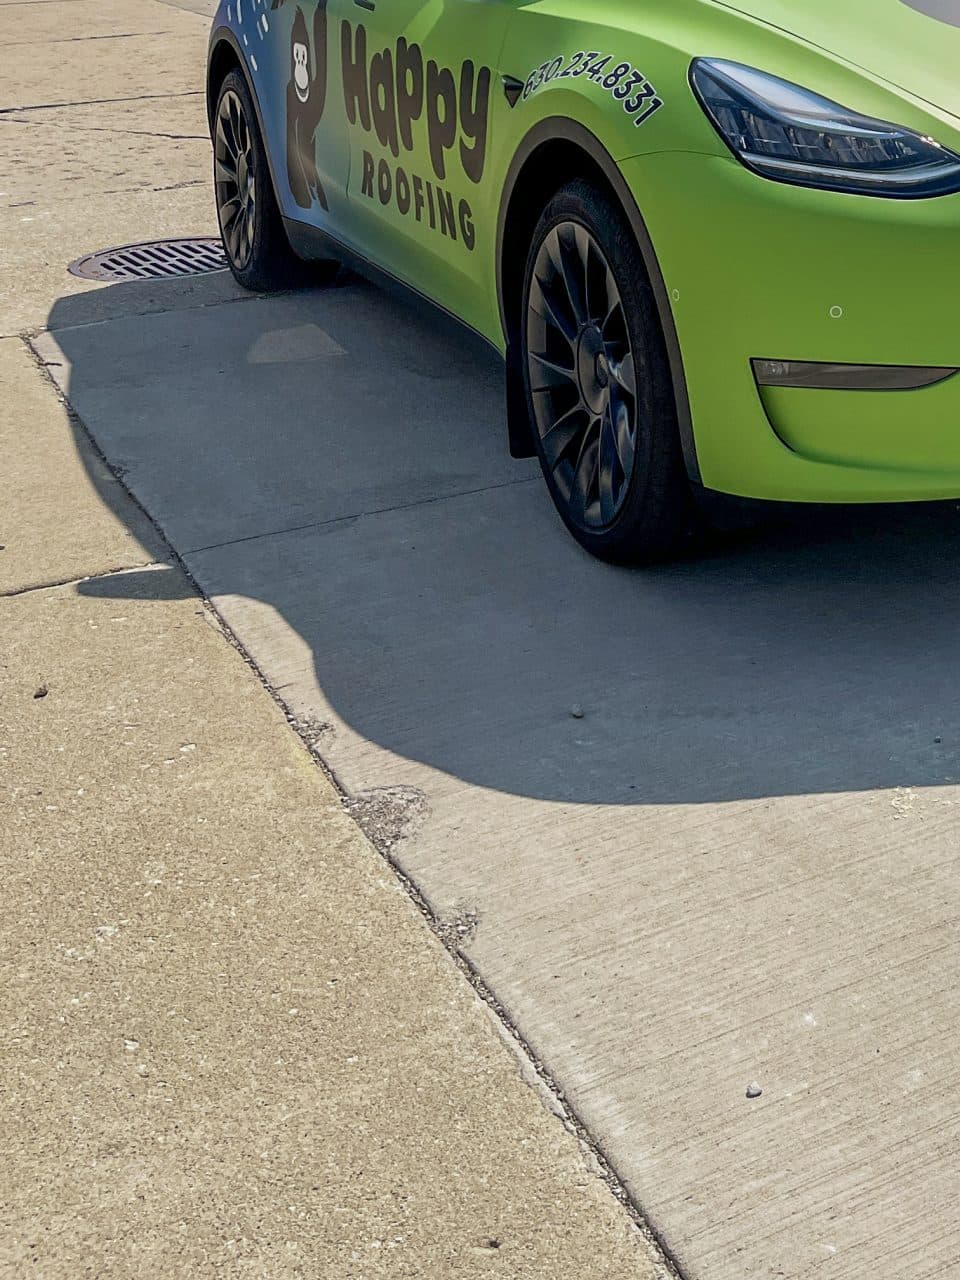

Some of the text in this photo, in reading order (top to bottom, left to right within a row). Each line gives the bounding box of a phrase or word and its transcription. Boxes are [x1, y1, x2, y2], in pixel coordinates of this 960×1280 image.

[341, 20, 491, 183] Happy
[522, 51, 664, 127] 630.234.8331
[361, 150, 476, 251] ROOFING
